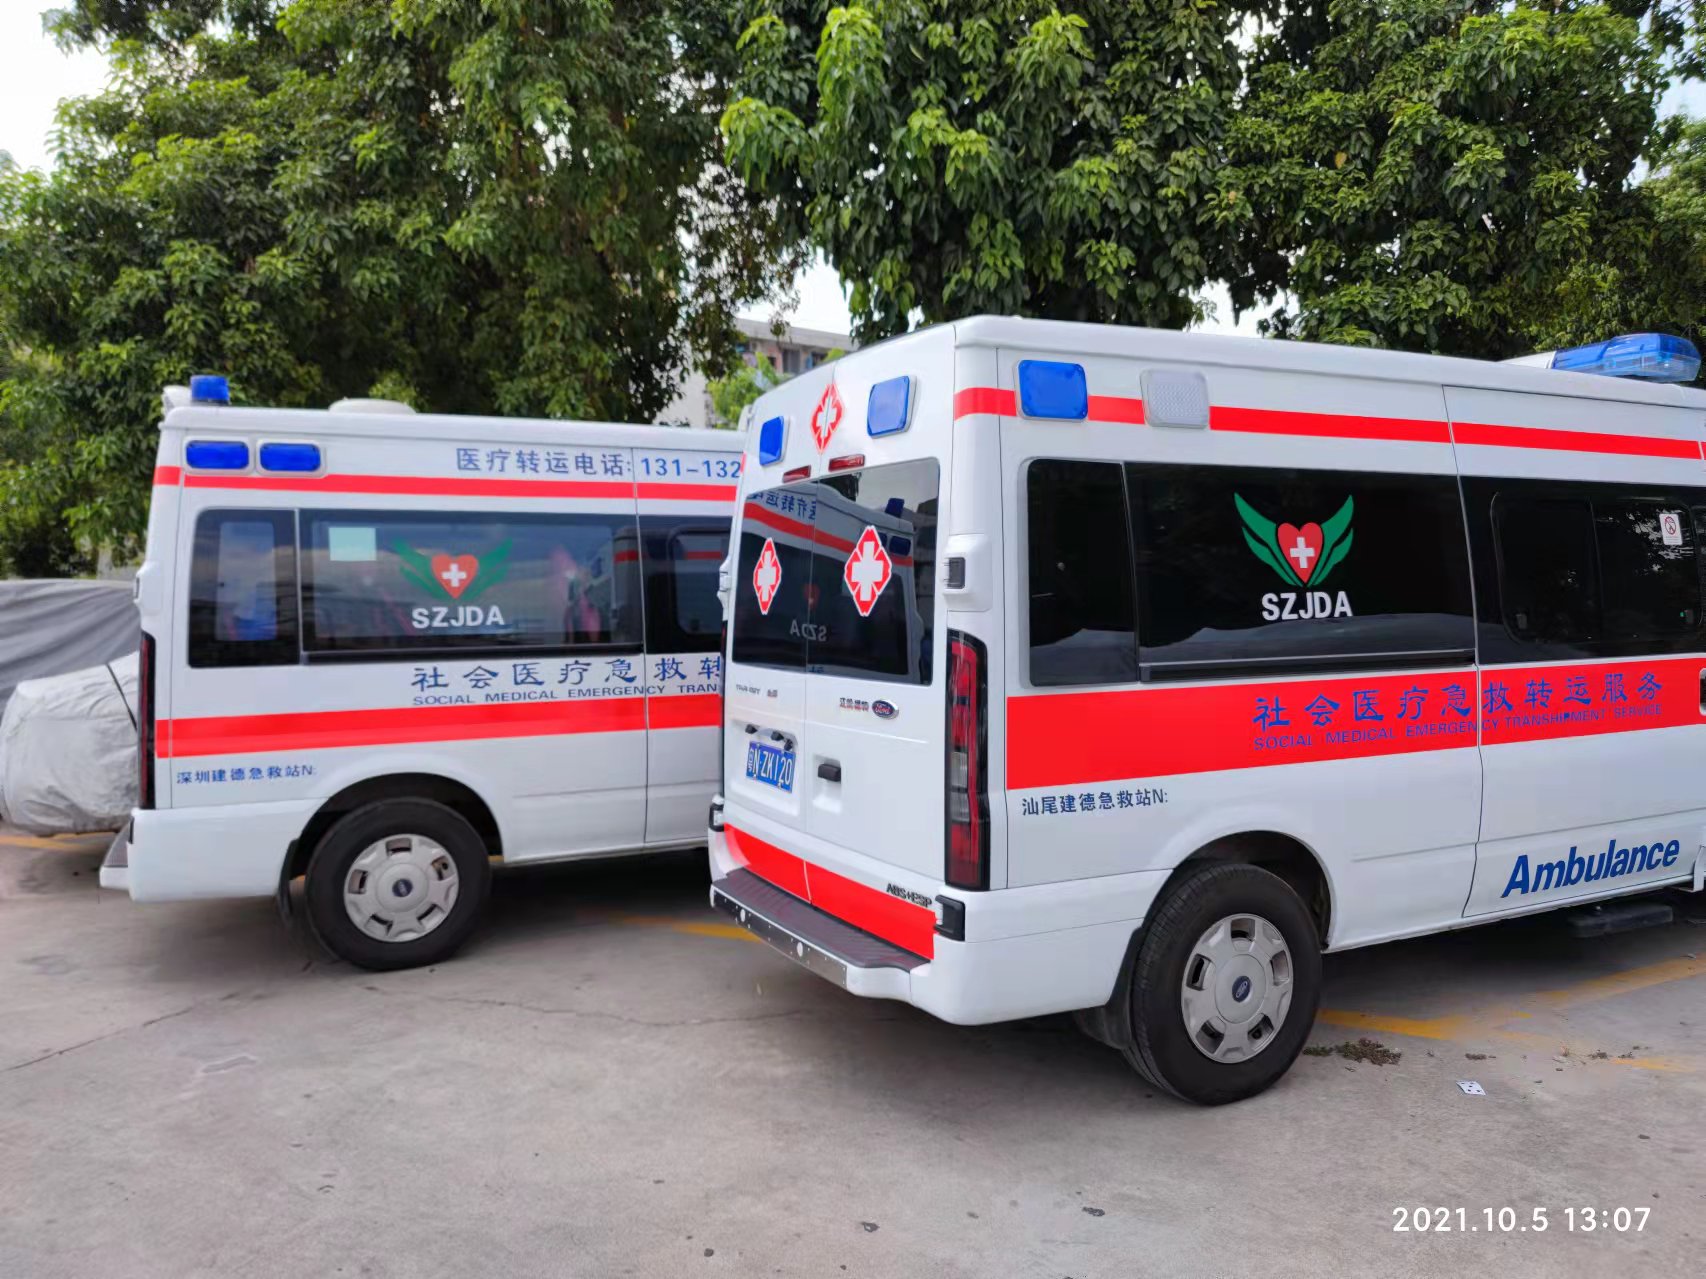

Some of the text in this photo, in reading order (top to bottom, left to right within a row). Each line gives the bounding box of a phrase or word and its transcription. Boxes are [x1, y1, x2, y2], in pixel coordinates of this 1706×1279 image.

[456, 448, 741, 479] 医疗转运电话: 131-132
[412, 605, 504, 629] SZJDA
[1262, 591, 1353, 621] SZJDA
[411, 655, 721, 692] 社会医疗急救转
[413, 683, 720, 706] SOCIAL MEDICAL EMERGENCY TRAN
[1253, 672, 1663, 732] 社会医疗急救转运服务
[1254, 703, 1662, 750] SOCIAL MEDICAL EMERGENCY TRANSHIPMENT SERVICE
[1022, 788, 1168, 816] 汕尾建德急救站N:
[1500, 839, 1680, 898] Ambulance
